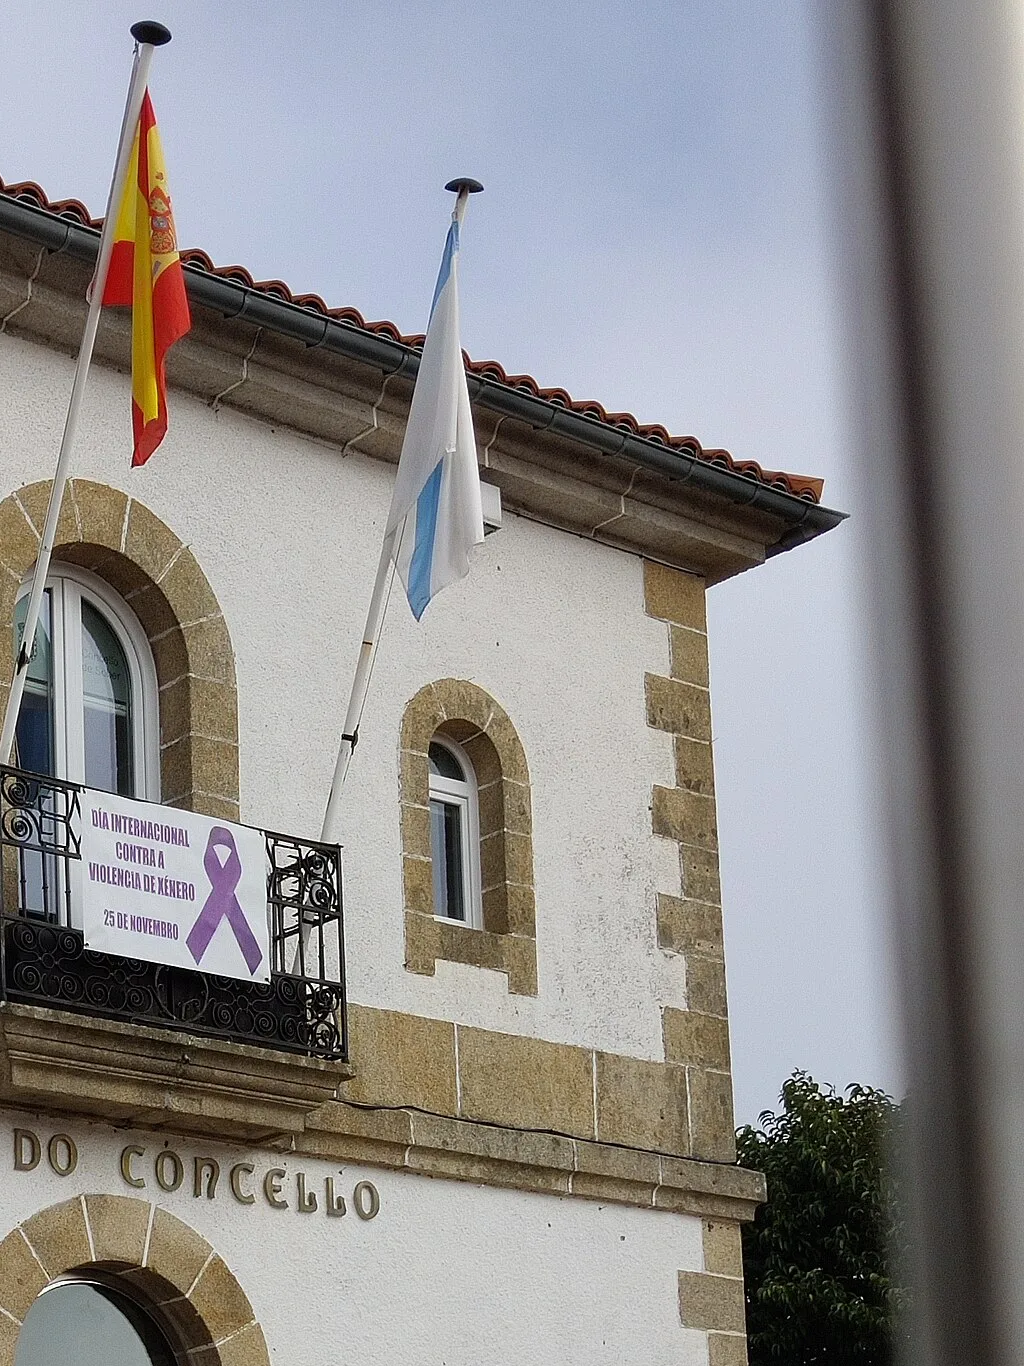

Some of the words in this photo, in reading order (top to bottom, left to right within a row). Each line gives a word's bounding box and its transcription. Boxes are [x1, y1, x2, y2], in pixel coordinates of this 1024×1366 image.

[91, 807, 109, 831] DÍA
[111, 814, 190, 848] INTERNACIONAL
[115, 841, 156, 868] CONTRA
[158, 850, 165, 869] A
[88, 862, 142, 891] VIOLENCIA
[143, 873, 156, 893] DE
[157, 875, 195, 901] XÉNERO
[103, 908, 115, 927] 25
[117, 912, 129, 931] DE
[130, 914, 179, 941] NOVEMBRO
[13, 1127, 77, 1177] DO
[120, 1144, 380, 1221] CONCELLO
